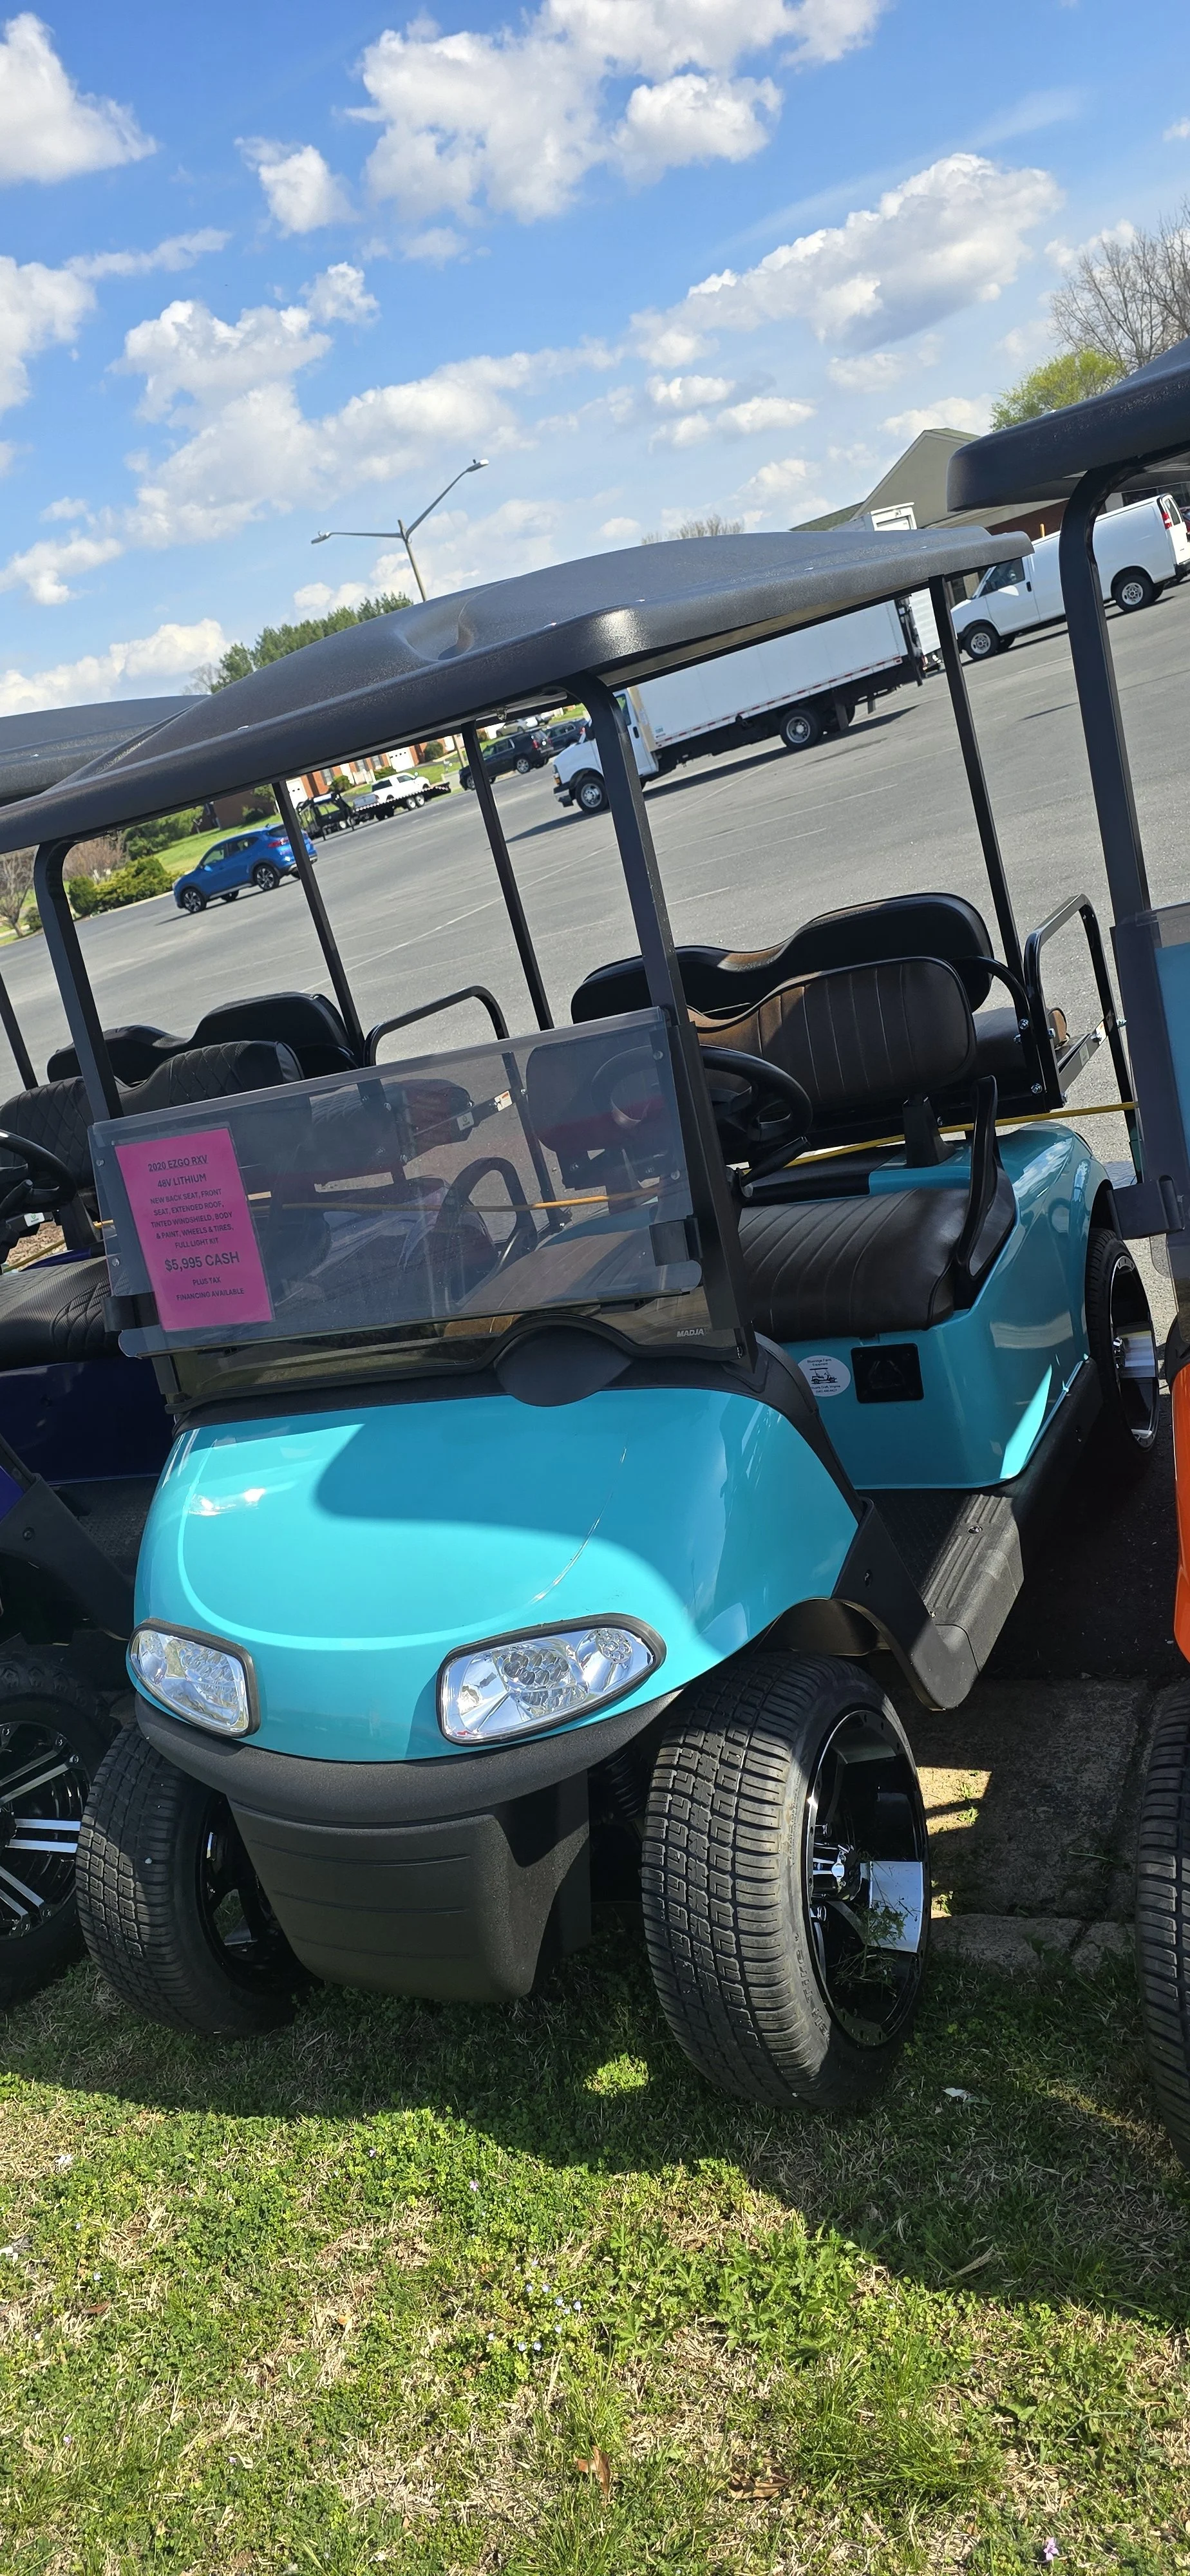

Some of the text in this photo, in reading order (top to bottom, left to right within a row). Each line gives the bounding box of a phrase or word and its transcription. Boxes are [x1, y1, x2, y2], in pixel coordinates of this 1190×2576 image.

[148, 1155, 208, 1172] 2020 EZGO RXV
[158, 1173, 207, 1188] 48V LITHIUM
[150, 1196, 166, 1204] NEW
[166, 1194, 182, 1202] BACK
[201, 1189, 222, 1198] FRONT
[153, 1201, 224, 1216] SEAT, EXTENDED ROOF,
[151, 1211, 232, 1228] TINTED WINDSHIELD, BODY
[162, 1230, 182, 1238] PAINT,
[182, 1227, 207, 1236] WHEELS
[191, 1238, 208, 1247] LIGHT
[165, 1251, 240, 1273] $5,995 CASH
[176, 1288, 245, 1301] FINANCING AVAILABLE
